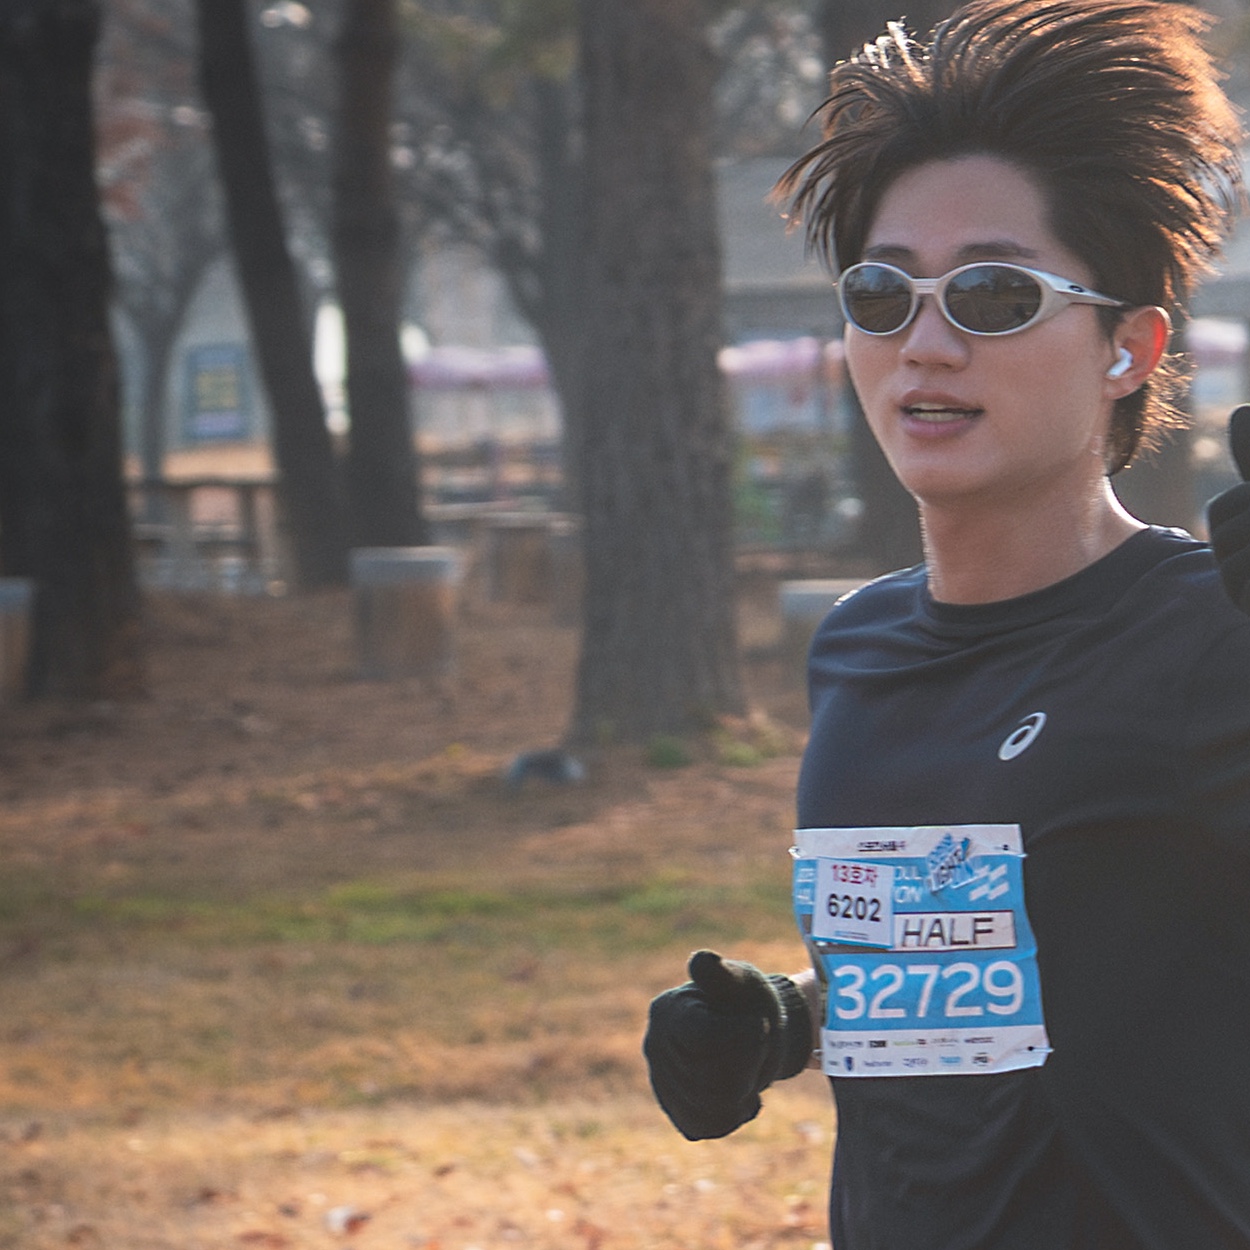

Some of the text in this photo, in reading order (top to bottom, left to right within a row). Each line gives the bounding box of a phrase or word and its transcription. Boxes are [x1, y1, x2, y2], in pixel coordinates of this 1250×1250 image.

[827, 893, 881, 922] 6202
[901, 916, 994, 948] HALF
[832, 960, 1025, 1020] 32729
